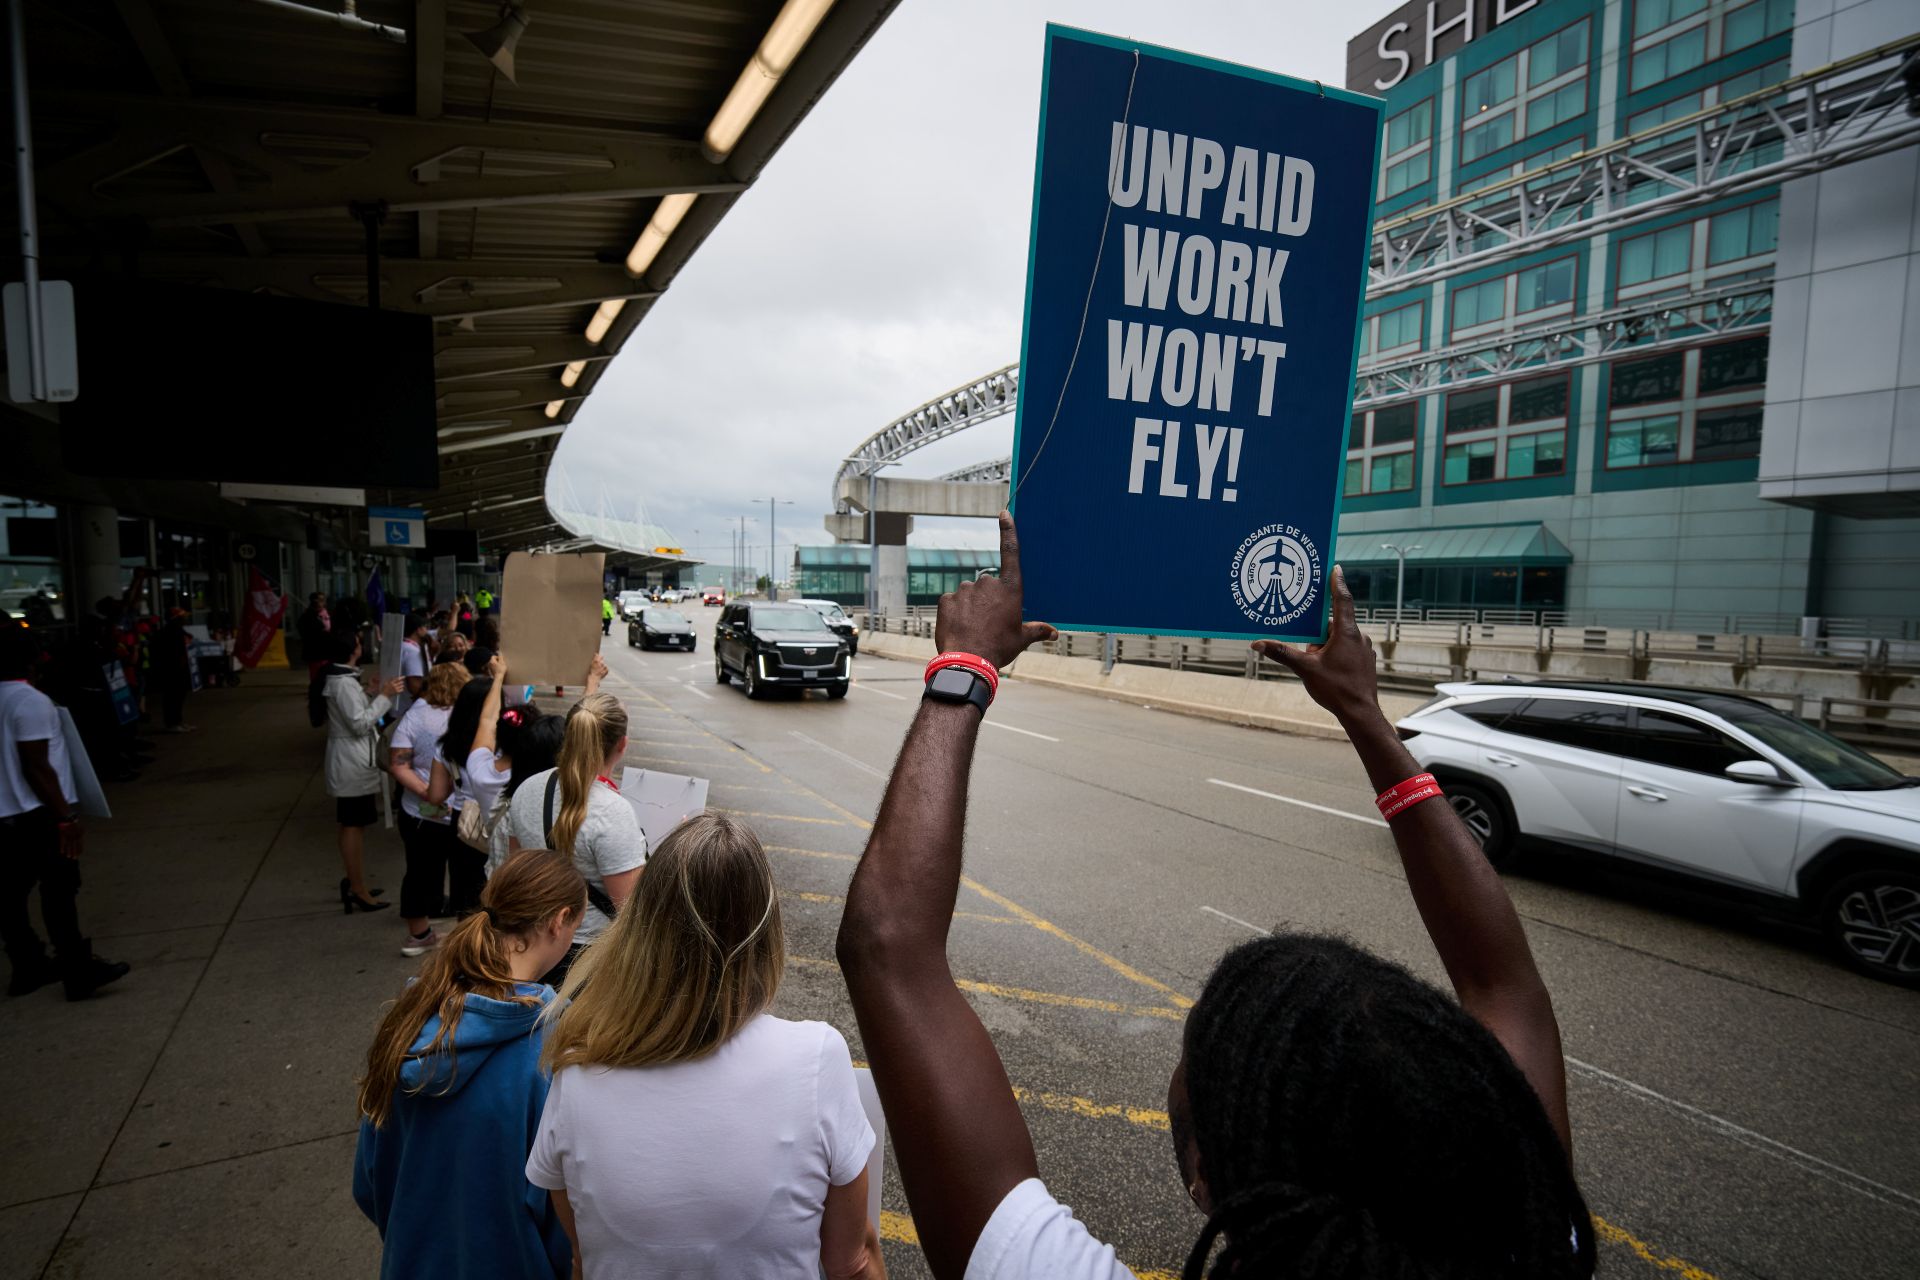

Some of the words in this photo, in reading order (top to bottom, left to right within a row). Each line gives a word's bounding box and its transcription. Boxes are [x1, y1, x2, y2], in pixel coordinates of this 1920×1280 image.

[1108, 121, 1315, 237] UNPAID
[1124, 223, 1290, 328] WORK
[1108, 319, 1287, 417] WON'T
[1128, 417, 1244, 502] FLY!
[1230, 524, 1283, 577] COMPOSANTE
[1286, 525, 1300, 538] DE
[1301, 534, 1320, 583] WESTJET
[1248, 562, 1256, 584] CUPE
[1230, 581, 1262, 622] WESTJET
[1264, 586, 1318, 625] COMPONENT
